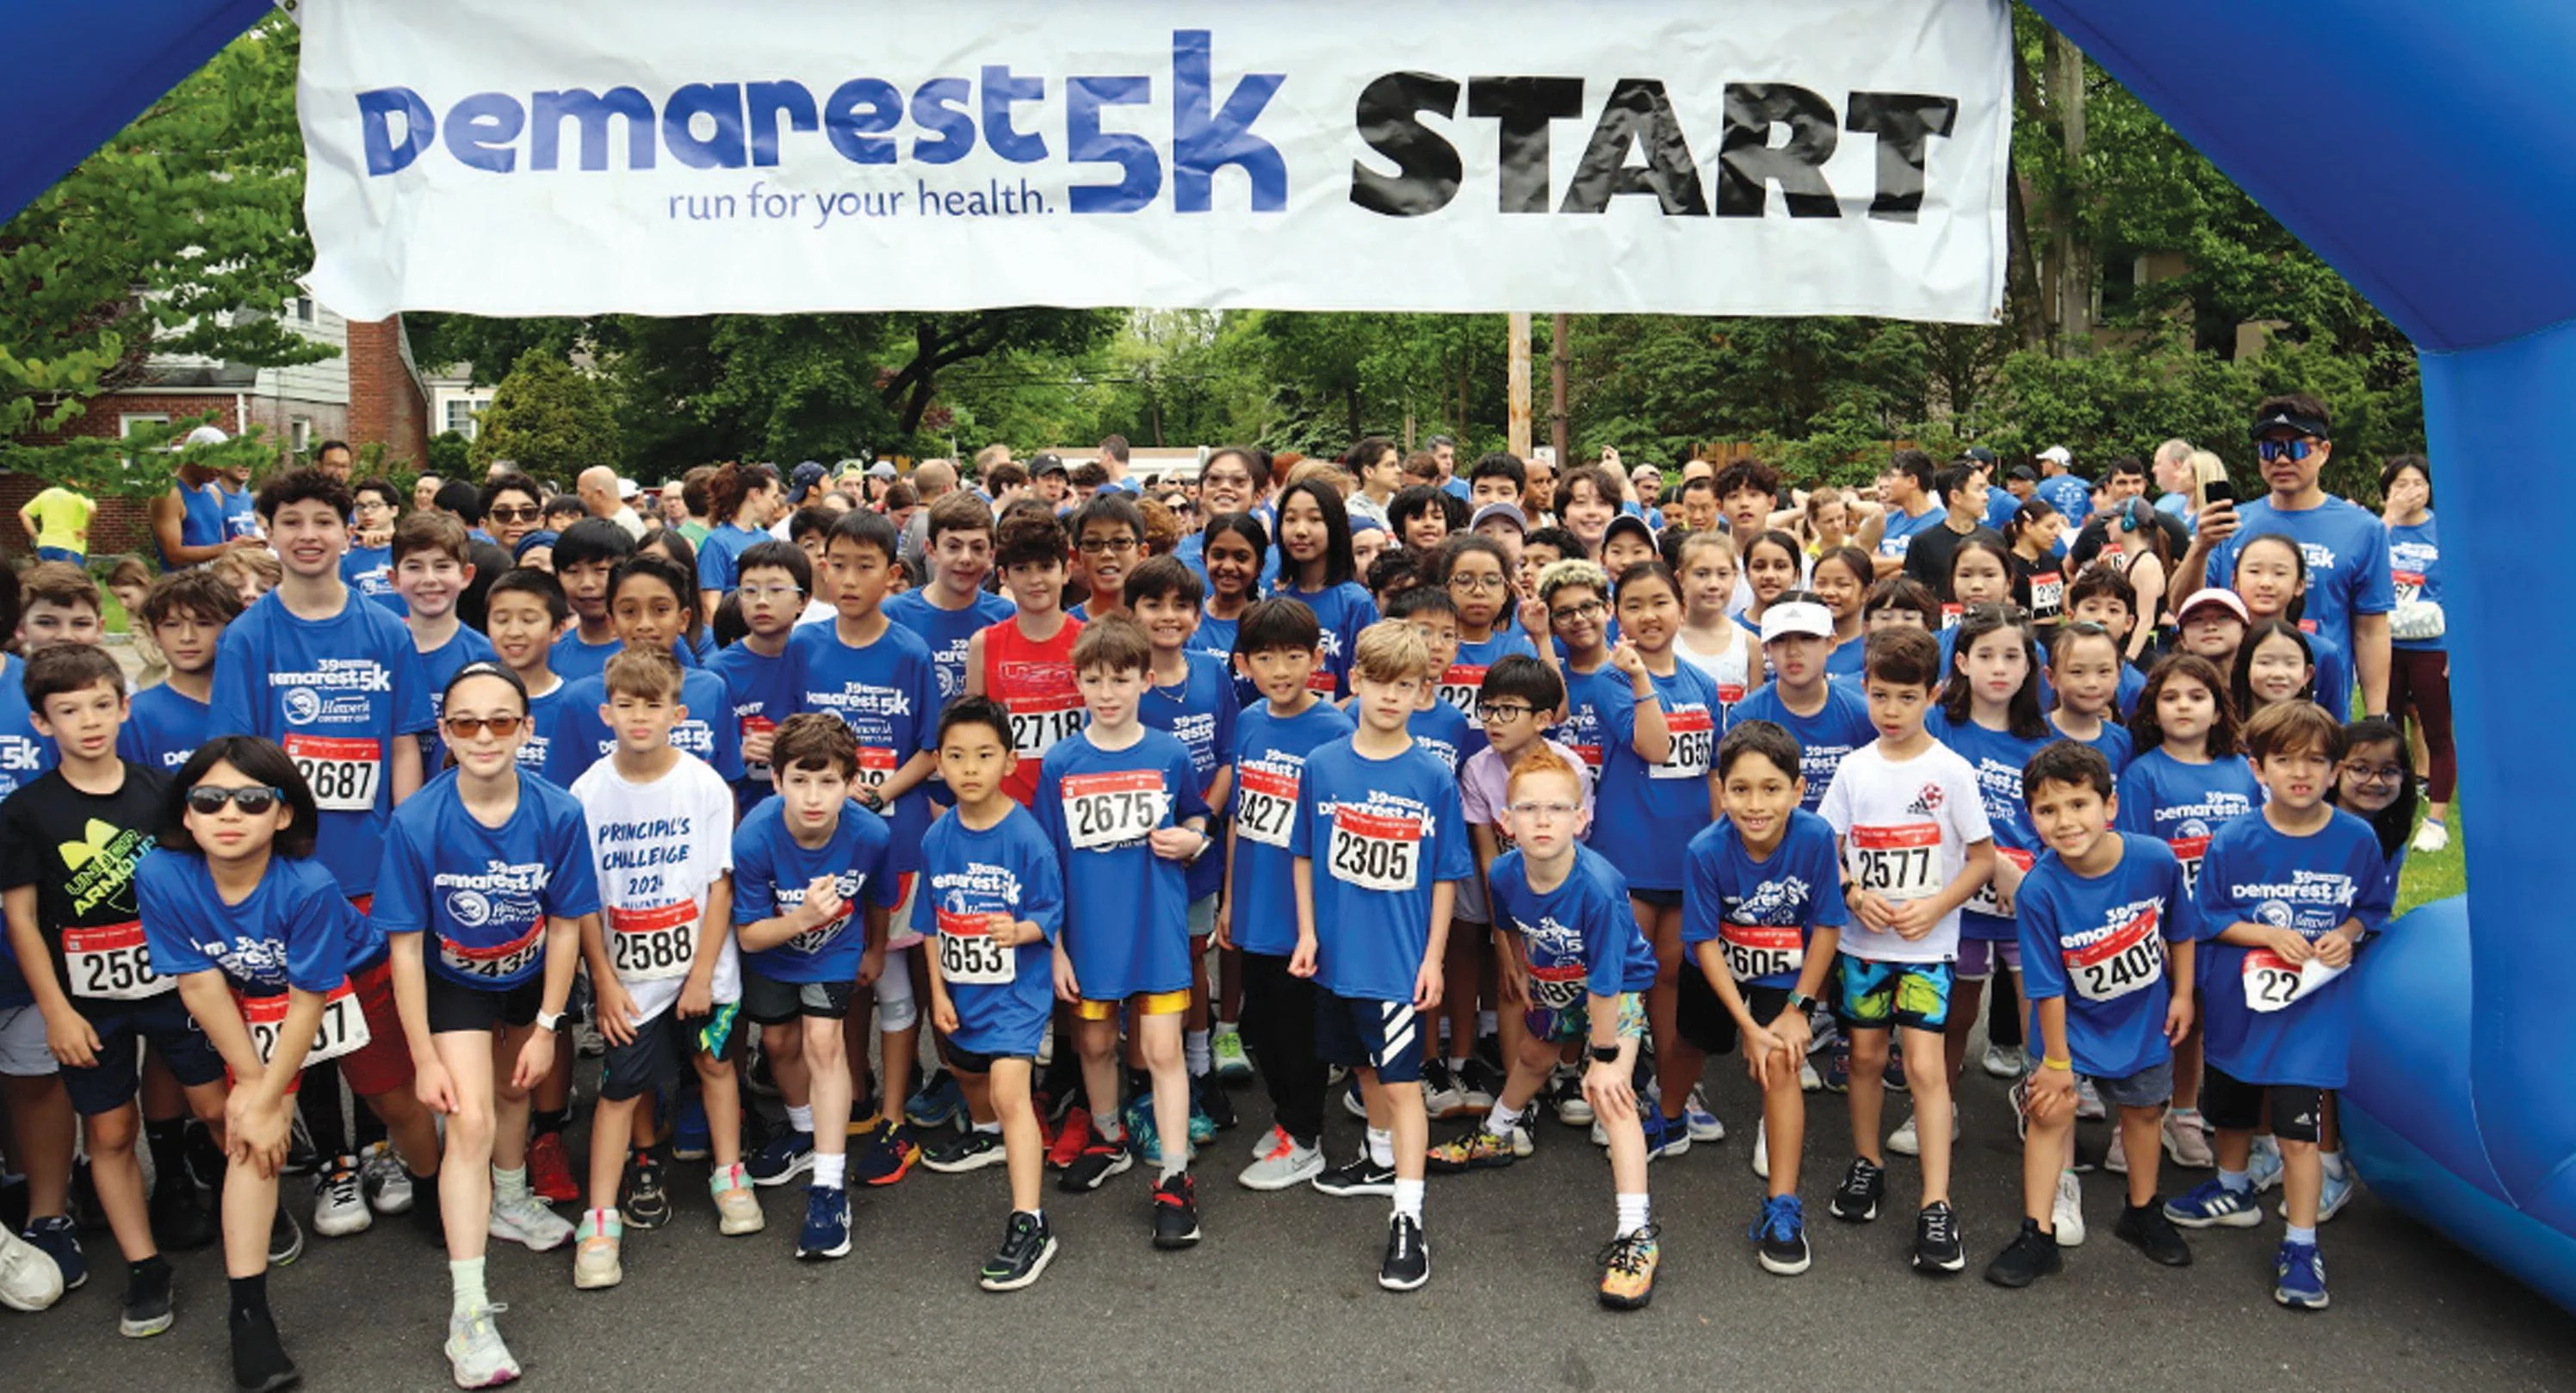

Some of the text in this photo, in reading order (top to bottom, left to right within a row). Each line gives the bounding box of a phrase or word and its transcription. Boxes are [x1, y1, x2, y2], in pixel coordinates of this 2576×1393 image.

[356, 30, 1288, 214] Demarest 5k
[1349, 71, 1959, 225] START
[669, 178, 1055, 229] run for your health.
[1012, 710, 1081, 750] 2718
[1074, 792, 1155, 836] 2675
[1335, 831, 1409, 880] 2305
[1859, 847, 1930, 890] 2577
[434, 873, 530, 891] emarest
[2232, 883, 2332, 899] Demarest
[84, 945, 161, 992] 258
[615, 925, 692, 971] 2588
[2084, 931, 2160, 994] 2405
